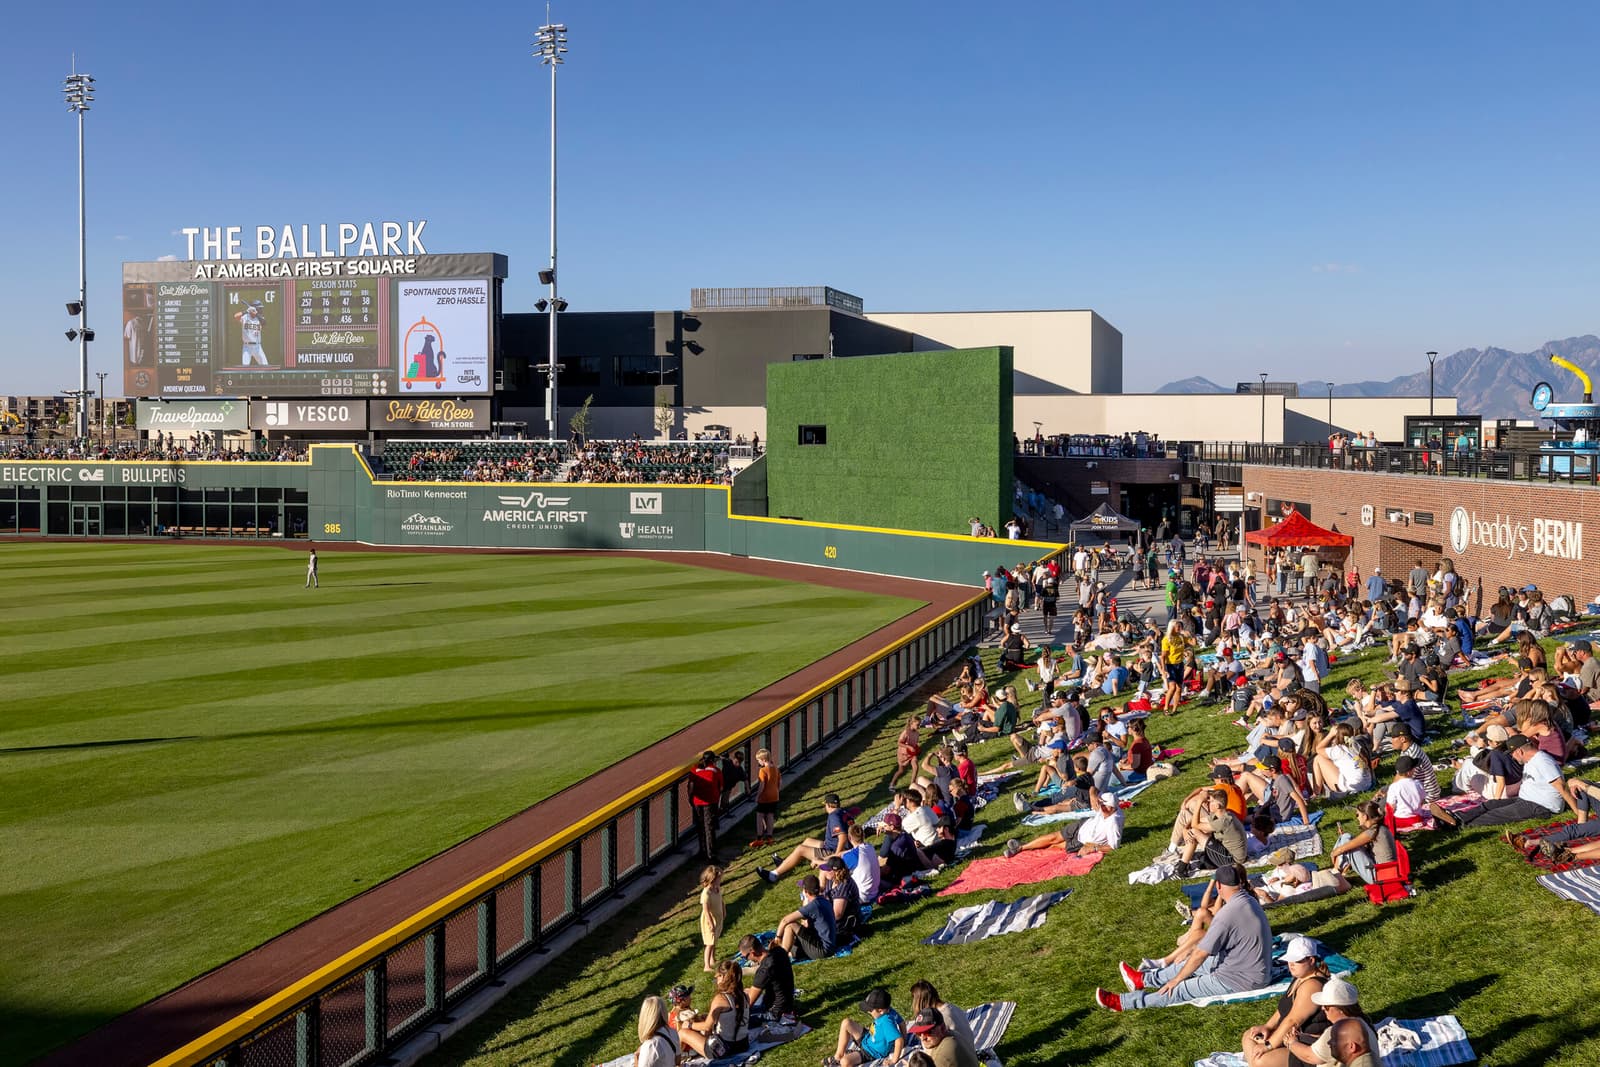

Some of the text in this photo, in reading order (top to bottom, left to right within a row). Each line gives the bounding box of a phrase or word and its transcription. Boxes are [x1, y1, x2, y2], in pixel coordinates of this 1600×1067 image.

[182, 220, 427, 260] THE BALLPARK
[194, 258, 416, 278] AT AMERICA FIRST SQUARE
[159, 285, 174, 296] Salt
[171, 285, 190, 296] Lake
[190, 284, 209, 296] Bees
[312, 279, 357, 289] SEASON STATS
[229, 290, 276, 305] 14 CF
[403, 287, 486, 296] SPONTANEOUS TRAVEL,
[342, 297, 350, 306] 47
[362, 297, 370, 305] 38
[436, 297, 456, 305] ZERO
[324, 315, 328, 323] 9
[312, 331, 364, 345] Salt Lake Bees
[298, 352, 354, 364] MATTHEW LUGO
[163, 385, 206, 393] ANDREW QUEZADA
[149, 406, 224, 428] Travelpass
[296, 406, 349, 422] YESCO
[386, 400, 474, 423] Salt Lake Bees
[3, 467, 73, 482] ELECTRIC
[122, 468, 186, 483] BULLPENS
[424, 489, 467, 499] Kennecott
[635, 497, 657, 509] LVT
[482, 510, 588, 523] AMERICA FIRST
[1101, 515, 1118, 523] KIDS
[324, 523, 341, 534] 385
[637, 525, 673, 535] HEALTH
[1472, 511, 1583, 560] beddy's BERM
[824, 545, 837, 559] 420
